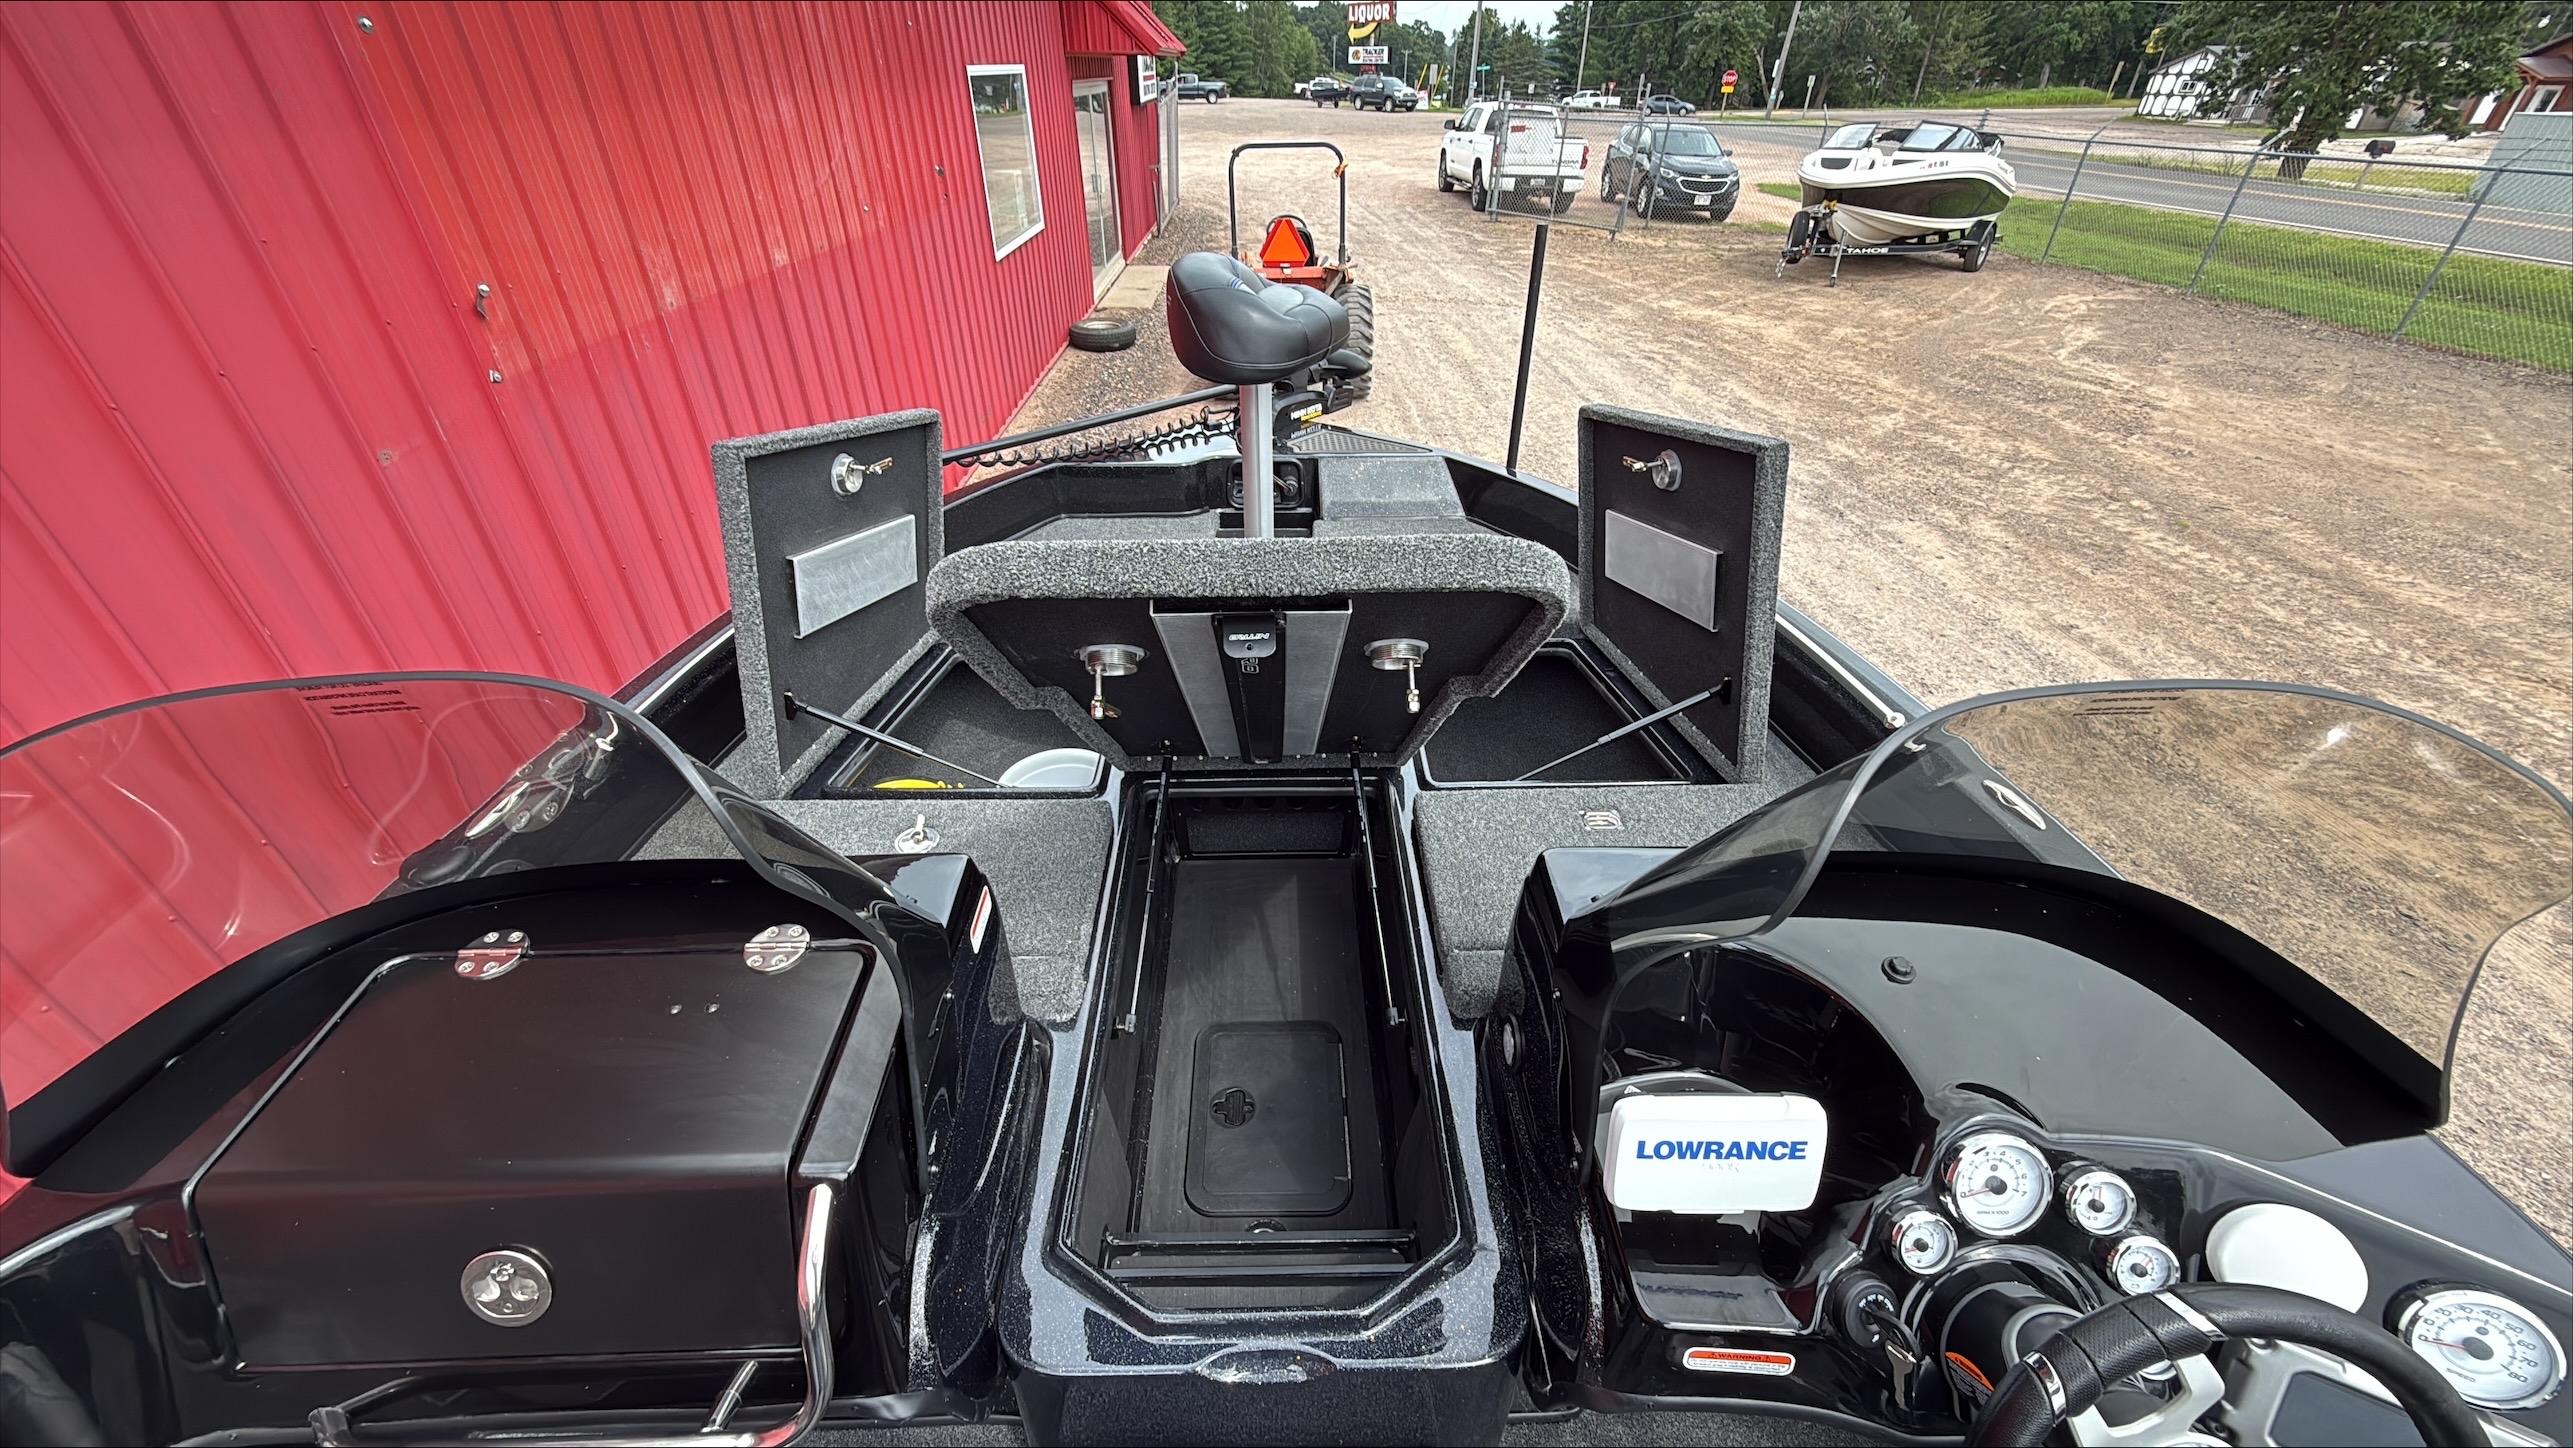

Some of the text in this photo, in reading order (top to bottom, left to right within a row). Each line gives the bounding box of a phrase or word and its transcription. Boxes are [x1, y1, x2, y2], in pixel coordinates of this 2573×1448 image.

[1348, 3, 1390, 23] LIQUOR
[1722, 74, 1737, 84] STOP
[1636, 1140, 1808, 1161] LOWRANCE
[1960, 1191, 1967, 1199] 0
[2481, 1309, 2501, 1320] 40
[2504, 1322, 2524, 1334] 50
[2517, 1339, 2537, 1350] 60
[1718, 1352, 1762, 1361] WARNING
[2518, 1355, 2538, 1368] 70
[2446, 1367, 2476, 1382] SPEED
[2507, 1371, 2528, 1383] 80
